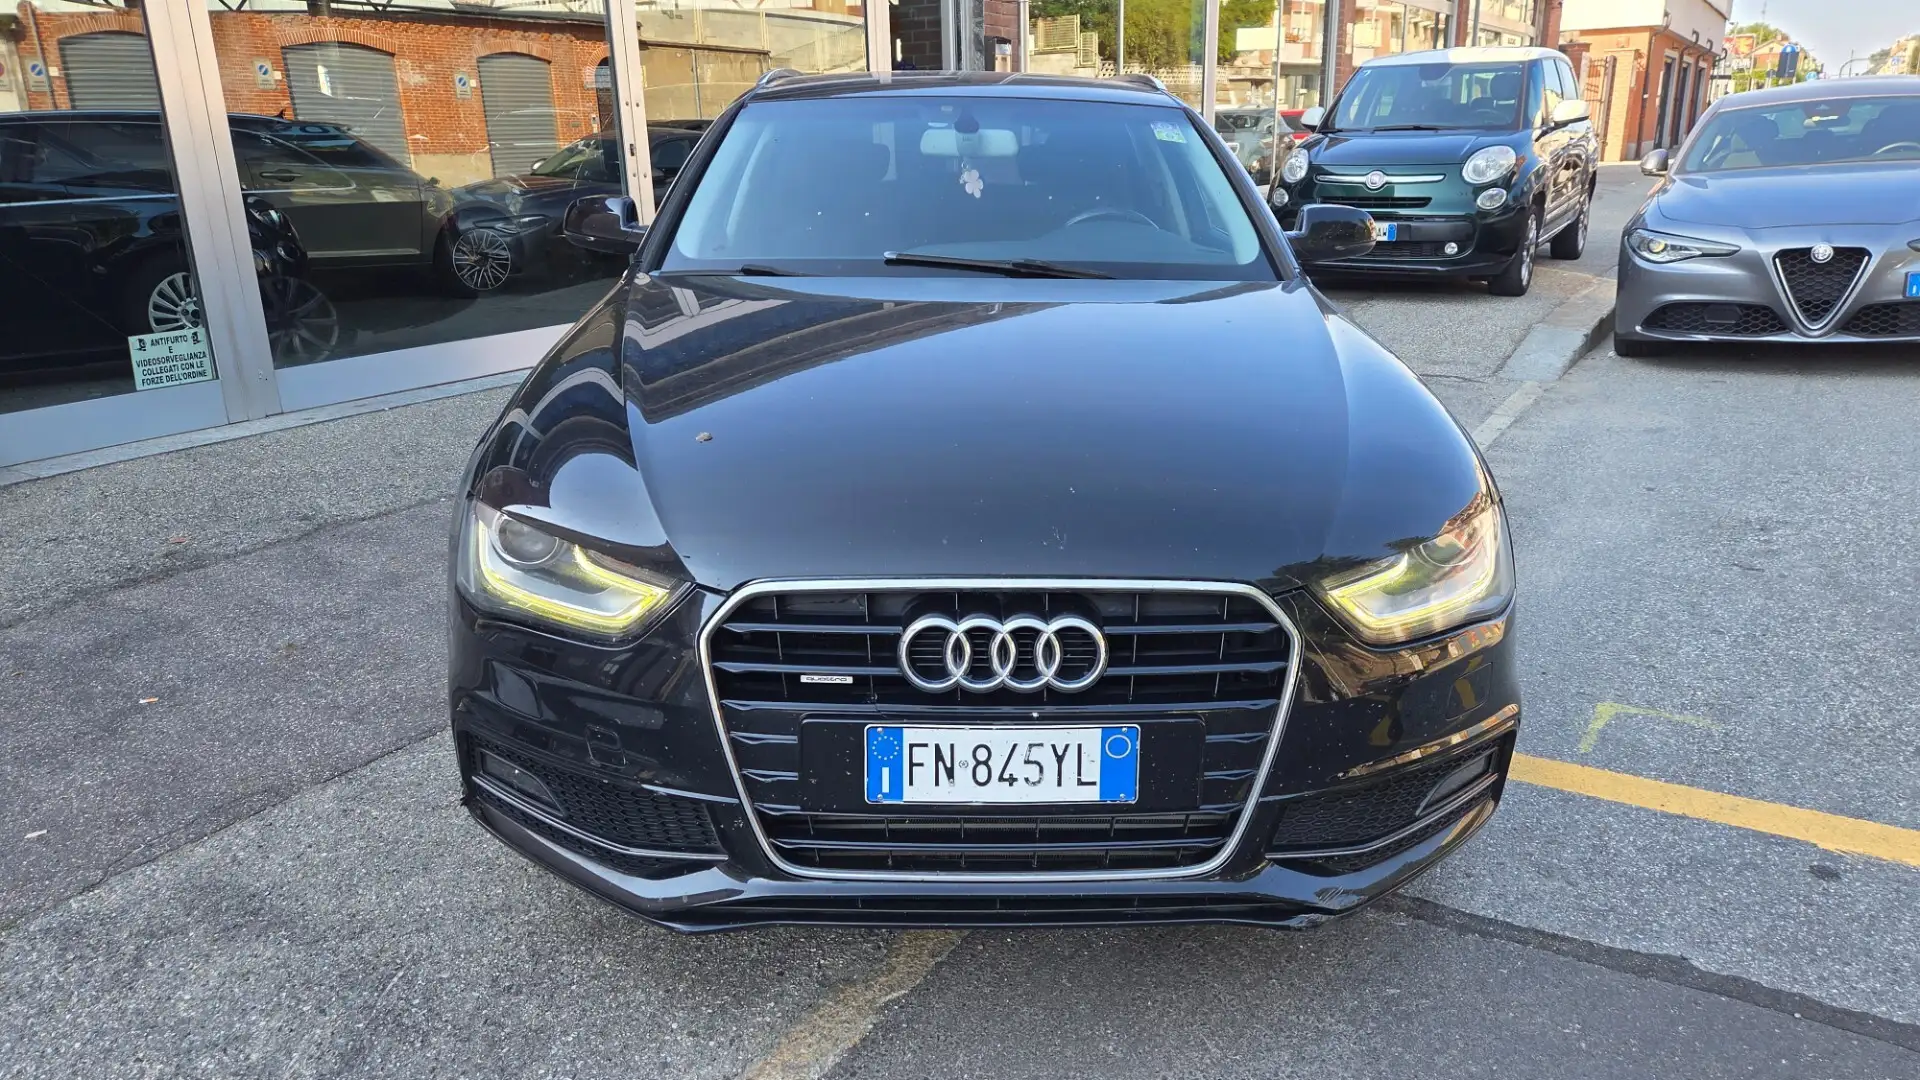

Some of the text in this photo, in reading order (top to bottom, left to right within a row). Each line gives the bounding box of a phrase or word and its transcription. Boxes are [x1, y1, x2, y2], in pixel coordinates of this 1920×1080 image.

[150, 335, 188, 347] ANTIFURTO
[168, 346, 173, 354] E
[136, 351, 207, 368] VIDEOSORVEGLIANZA
[142, 360, 204, 376] COLLEGATI CON LE
[142, 369, 207, 387] FORZE DELL'ORDINE
